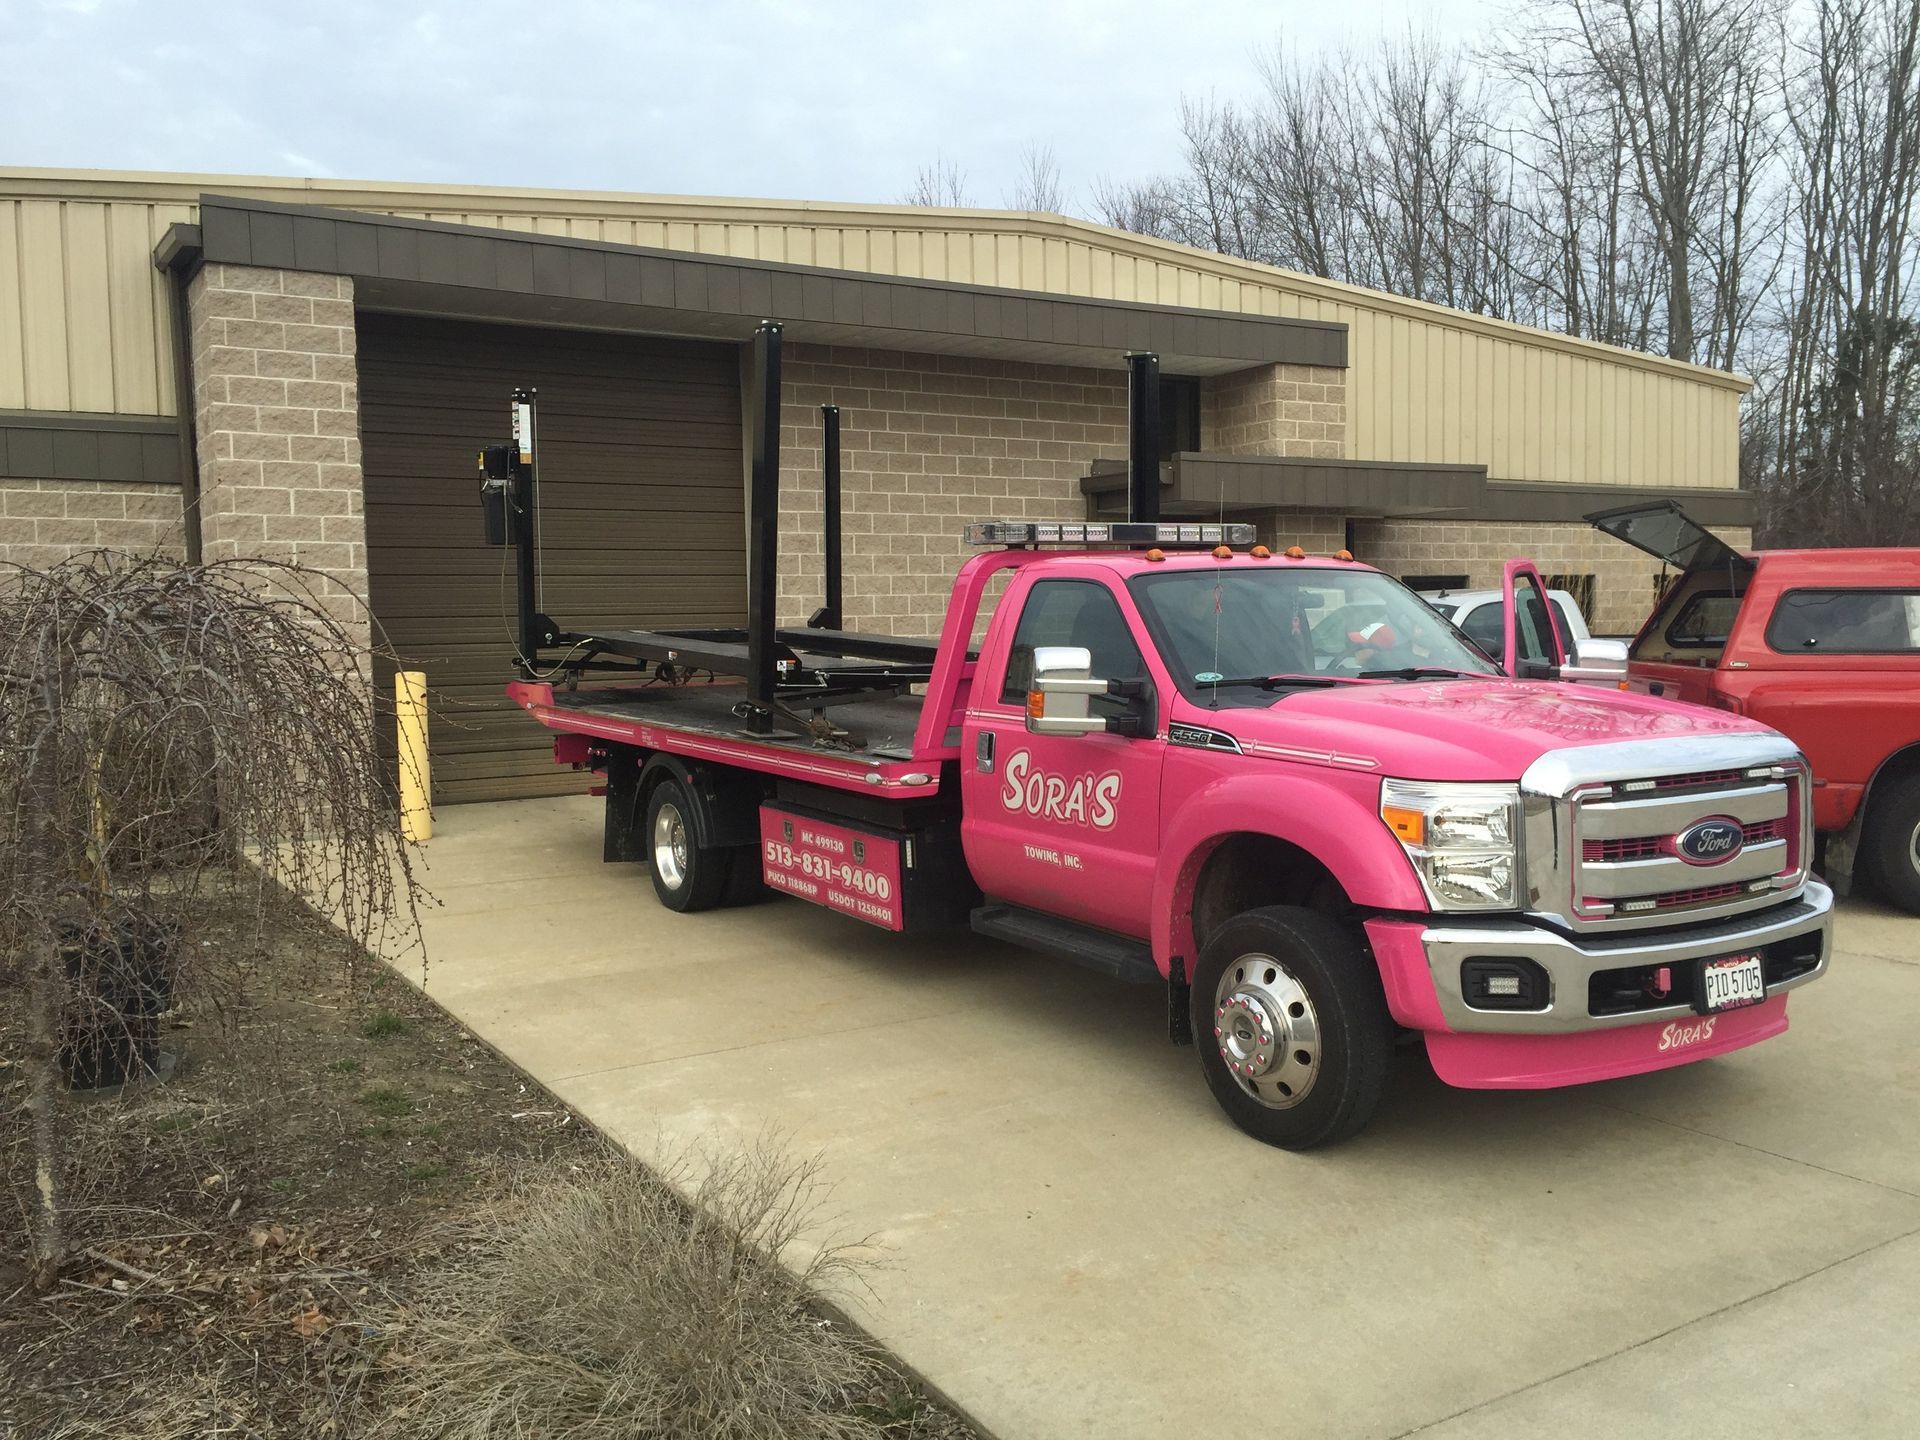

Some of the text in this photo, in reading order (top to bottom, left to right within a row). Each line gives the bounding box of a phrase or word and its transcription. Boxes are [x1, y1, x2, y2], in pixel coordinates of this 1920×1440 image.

[801, 831, 844, 853] MC 499130
[1697, 828, 1732, 853] Ford
[766, 841, 890, 899] 513-831-9400
[1064, 853, 1083, 869] INC.
[767, 871, 786, 885] PUCO
[828, 890, 892, 922] USDOT 1258401
[1707, 966, 1761, 999] PID 5705
